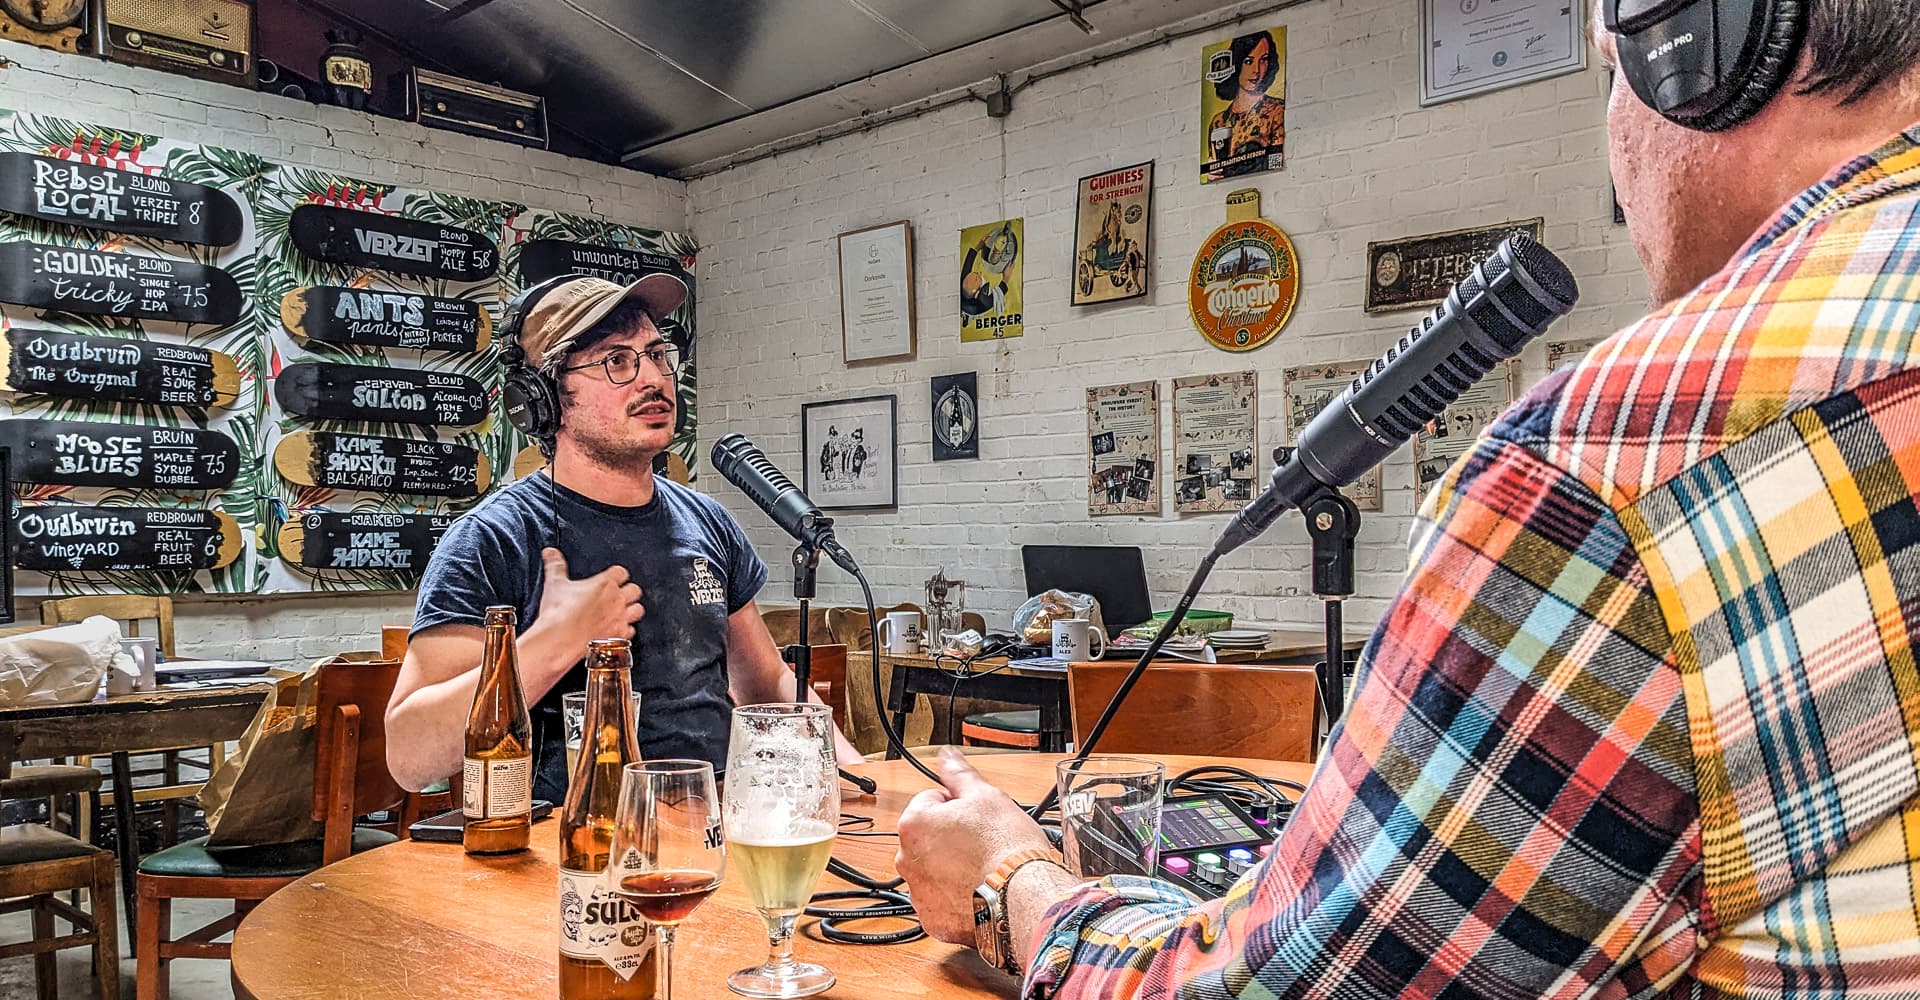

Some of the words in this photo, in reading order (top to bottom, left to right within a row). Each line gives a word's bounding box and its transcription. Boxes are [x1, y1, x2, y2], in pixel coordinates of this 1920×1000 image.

[1674, 33, 1693, 48] PRO
[132, 175, 171, 193] BLOND
[1089, 168, 1144, 191] GUINNESS
[1089, 193, 1104, 204] FOR
[1105, 184, 1144, 200] STRENGTH
[35, 187, 128, 222] LOCAL
[132, 195, 180, 211] VERZET
[440, 230, 469, 243] BLOND
[354, 228, 439, 263] VERZET
[43, 250, 129, 278] GOLDEN
[138, 258, 172, 273] BLOND
[440, 257, 467, 272] ALE
[572, 250, 639, 270] unwanted
[643, 255, 670, 267] BLOND
[138, 278, 171, 289] SINGLE
[49, 277, 135, 313] tricky
[145, 288, 166, 299] HOP
[139, 301, 169, 313] IPA
[335, 292, 425, 327] ANTS
[434, 301, 466, 312] BROWN
[975, 313, 1023, 330] BERGER
[347, 321, 399, 339] pants
[404, 330, 425, 338] NITRO
[992, 327, 1005, 338] 45
[432, 331, 464, 344] PORTER
[162, 365, 197, 378] REAL
[162, 376, 197, 390] SOUR
[364, 379, 415, 390] caravan
[427, 374, 464, 386] BLOND
[160, 389, 197, 403] BEER
[433, 391, 468, 403] ALCOHOL
[434, 404, 464, 413] ARME
[438, 412, 461, 422] IPA
[335, 436, 384, 454] KAME
[406, 443, 435, 455] BLACK
[154, 452, 196, 464] MAPLE
[54, 456, 144, 478] BLUES
[154, 461, 193, 475] SYRUP
[154, 474, 199, 485] DUBBEL
[327, 472, 393, 488] BALSAMICO
[146, 511, 205, 524] REDBROWN
[351, 515, 404, 527] NAKED
[157, 530, 193, 542] REAL
[350, 532, 400, 548] KAME
[154, 542, 193, 553] FRUIT
[160, 553, 193, 566] BEER
